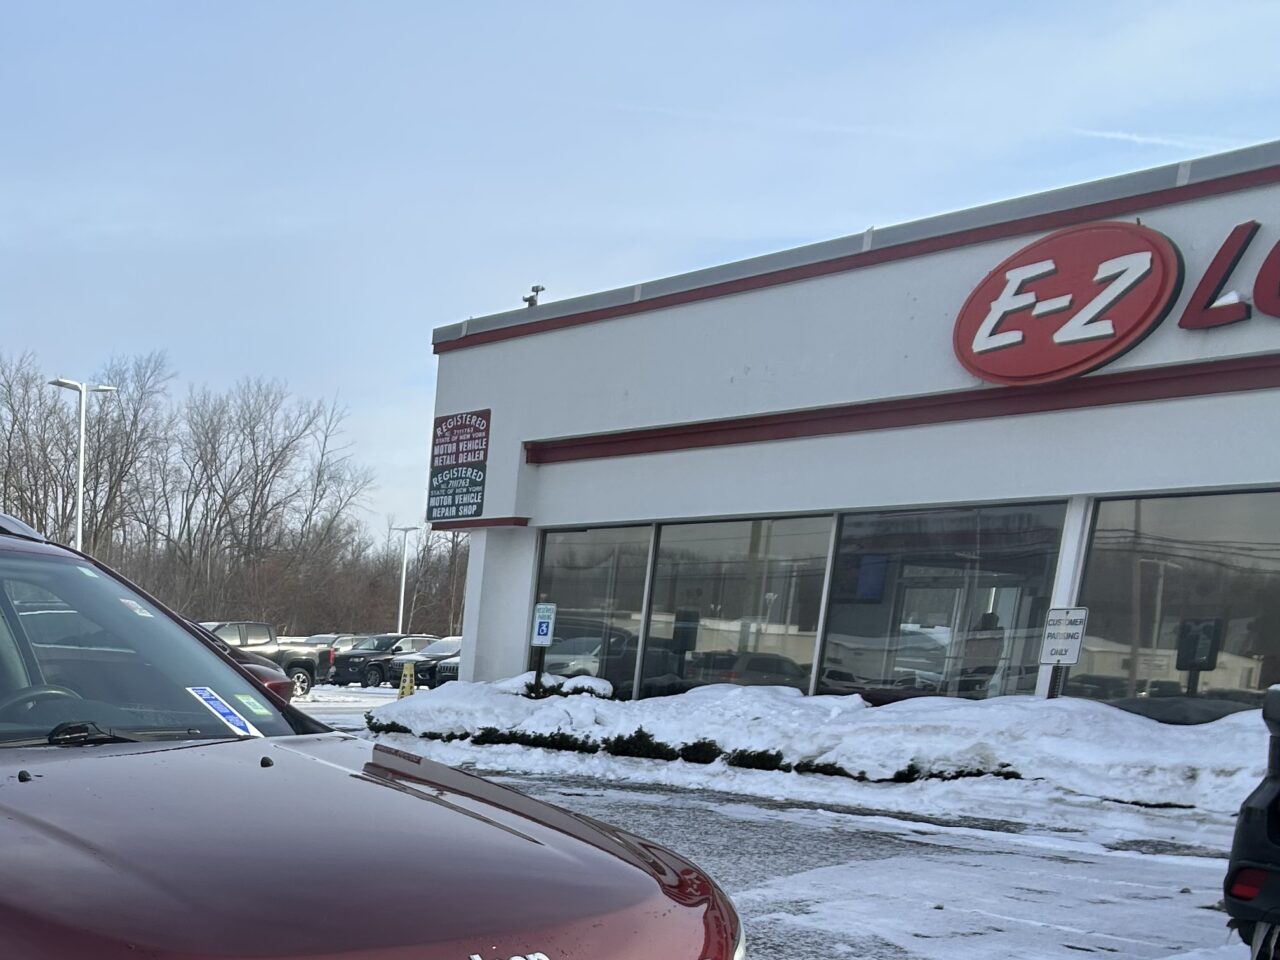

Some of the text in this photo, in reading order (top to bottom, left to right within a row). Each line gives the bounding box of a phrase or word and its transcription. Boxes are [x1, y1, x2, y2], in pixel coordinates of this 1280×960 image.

[972, 251, 1152, 353] E-Z
[436, 413, 487, 437] REGISTERED
[434, 438, 487, 455] MOTOR VEHICLE
[434, 450, 485, 466] RETAIL DEALER
[432, 467, 484, 487] REGISTERED
[429, 492, 483, 506] MOTOR VEHICLE
[432, 504, 477, 518] REPAIR SHOP
[1050, 648, 1069, 656] ONLY
